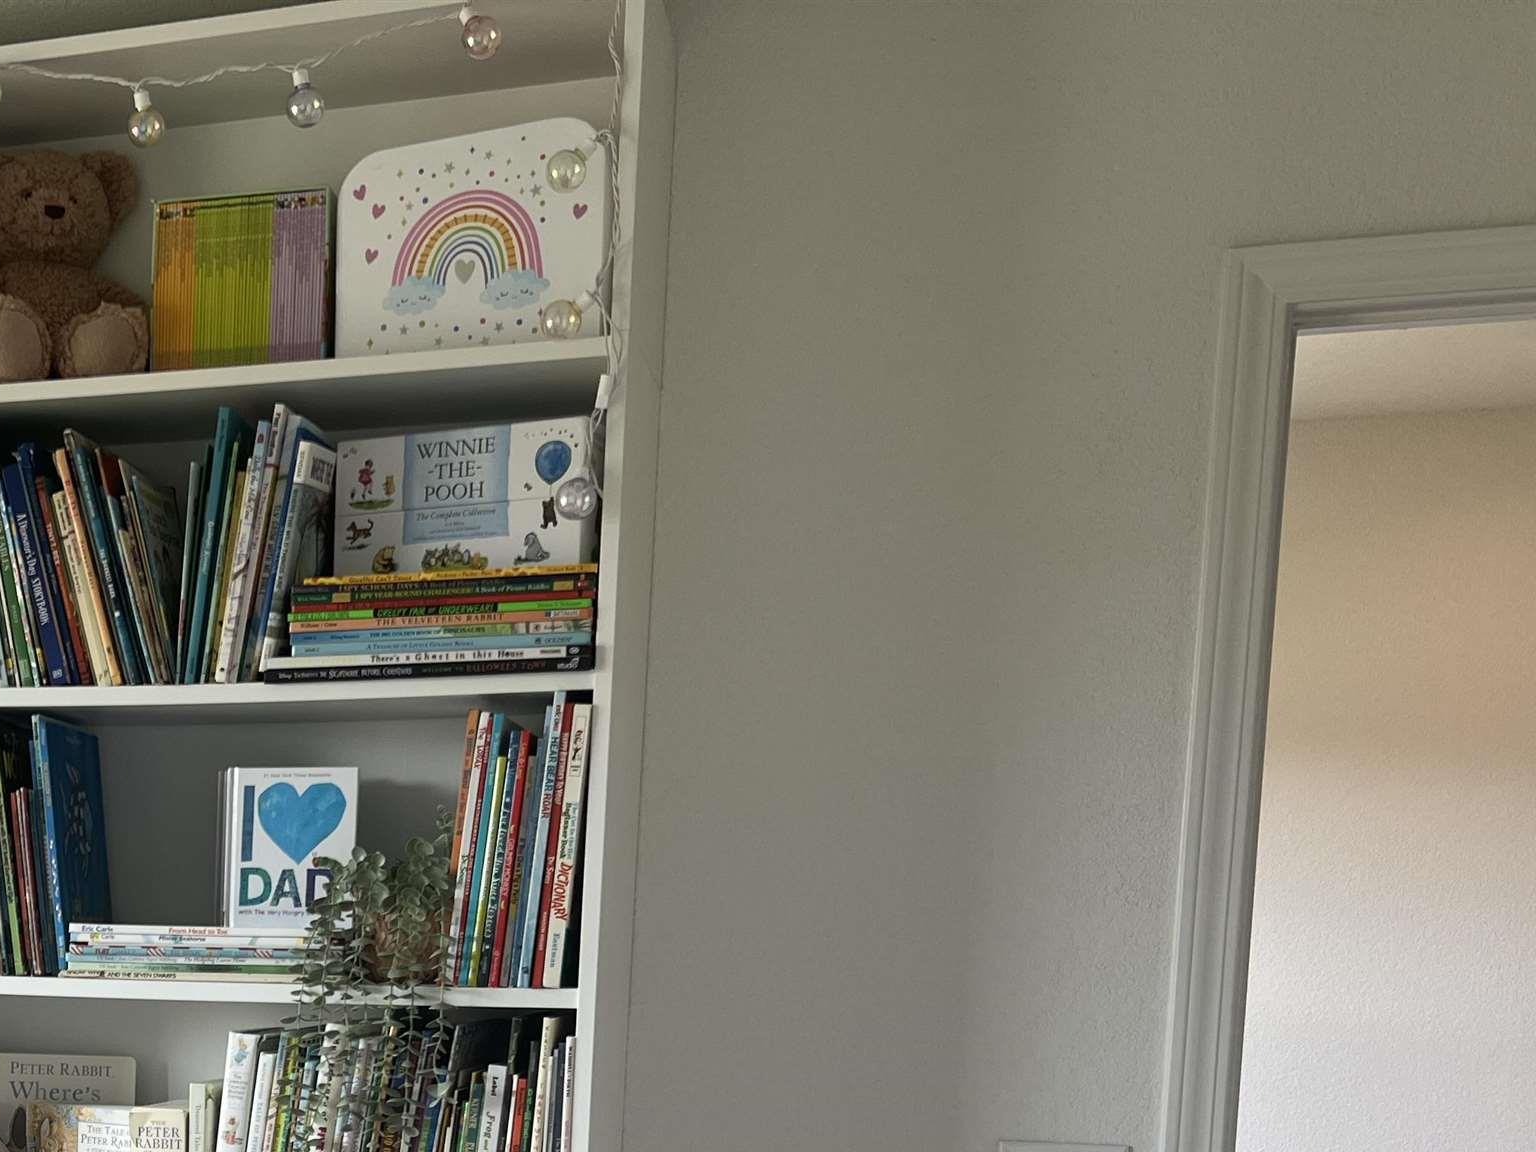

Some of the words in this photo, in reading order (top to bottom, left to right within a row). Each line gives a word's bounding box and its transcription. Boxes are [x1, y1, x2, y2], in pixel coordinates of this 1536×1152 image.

[417, 436, 496, 461] WINNIE
[424, 480, 485, 503] POOH
[416, 511, 428, 521] The
[26, 559, 39, 577] Day
[31, 578, 49, 627] STORYBOOK
[375, 619, 391, 627] THE
[393, 616, 464, 626] VELVETEEN
[467, 614, 504, 623] RABBIT
[370, 653, 400, 663] There's
[415, 651, 450, 662] Ghost
[455, 651, 464, 660] in
[472, 650, 492, 659] this
[497, 649, 525, 659] House
[548, 735, 559, 762] HEAR
[545, 764, 556, 791] BEAR
[541, 792, 552, 819] ROAR
[241, 785, 255, 861] I
[551, 861, 574, 922] DICTIONARY
[186, 927, 204, 935] Head
[9, 1061, 56, 1076] PETER
[59, 1062, 112, 1077] RABBIT
[9, 1080, 101, 1102] Where's
[490, 1075, 499, 1096] Lobel
[87, 1125, 104, 1135] THE
[107, 1126, 126, 1137] TALE
[137, 1127, 180, 1138] PETER
[482, 1111, 496, 1138] Frog
[80, 1134, 108, 1146] PETER
[135, 1138, 183, 1150] RABBIT
